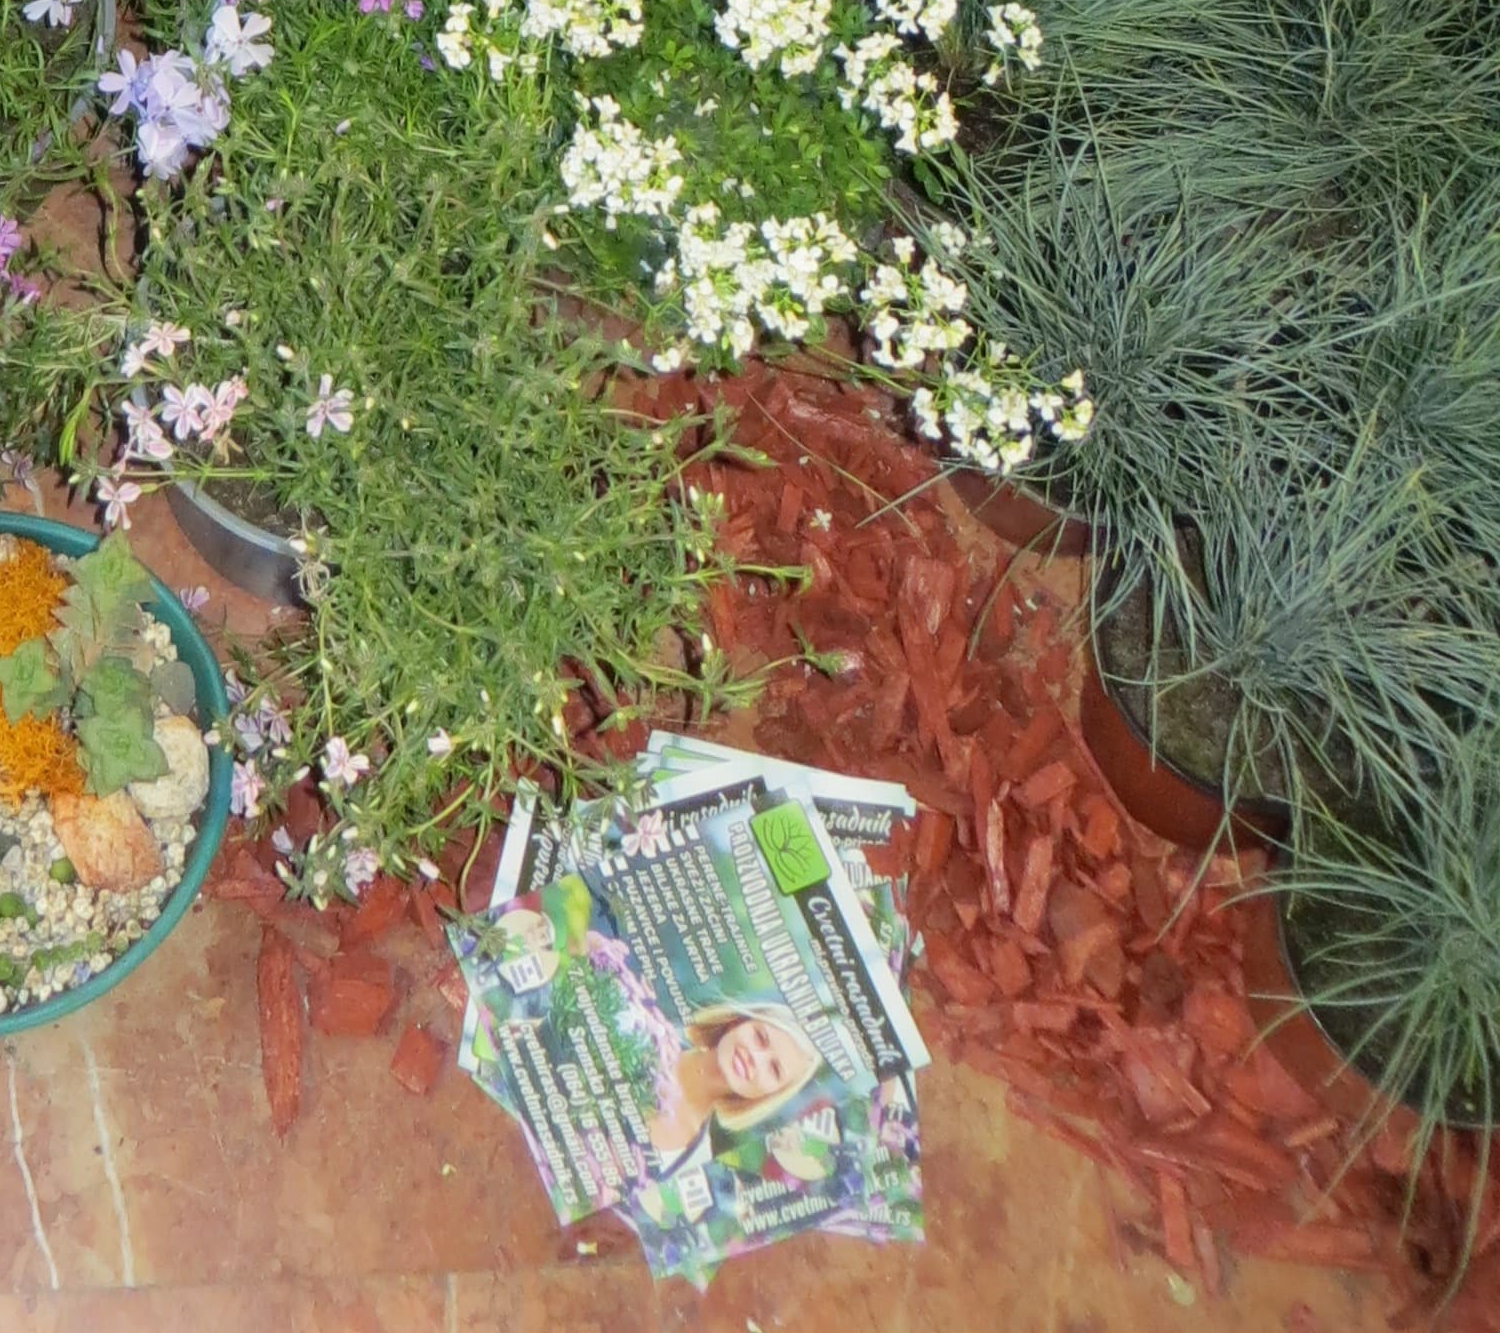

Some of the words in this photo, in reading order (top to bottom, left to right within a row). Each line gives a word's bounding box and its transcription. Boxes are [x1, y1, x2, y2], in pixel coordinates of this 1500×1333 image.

[621, 874, 660, 946] PUZAVICE
[635, 867, 667, 924] JEZERA
[649, 862, 680, 911] BILJKE
[670, 911, 689, 933] ZA
[681, 935, 710, 983] VRTNA
[664, 856, 703, 925] UKRASNE
[695, 928, 724, 975] TRAVE
[693, 843, 757, 973] PERENE-TRAJNICE
[727, 820, 784, 936] PROIZVODNJA
[760, 930, 824, 1019] UKRASNIH
[803, 1014, 858, 1081] BILJAKA
[805, 894, 855, 969] Cvetni
[839, 969, 903, 1067] rasadnik
[497, 1024, 580, 1206] www.cvetnirasadnik.rs
[519, 1021, 599, 1197] cvetniras@gmail.com
[555, 1060, 589, 1107] (064)
[566, 1024, 608, 1095] Sremska
[596, 1096, 640, 1178] Kamenica
[614, 1081, 652, 1145] brigade
